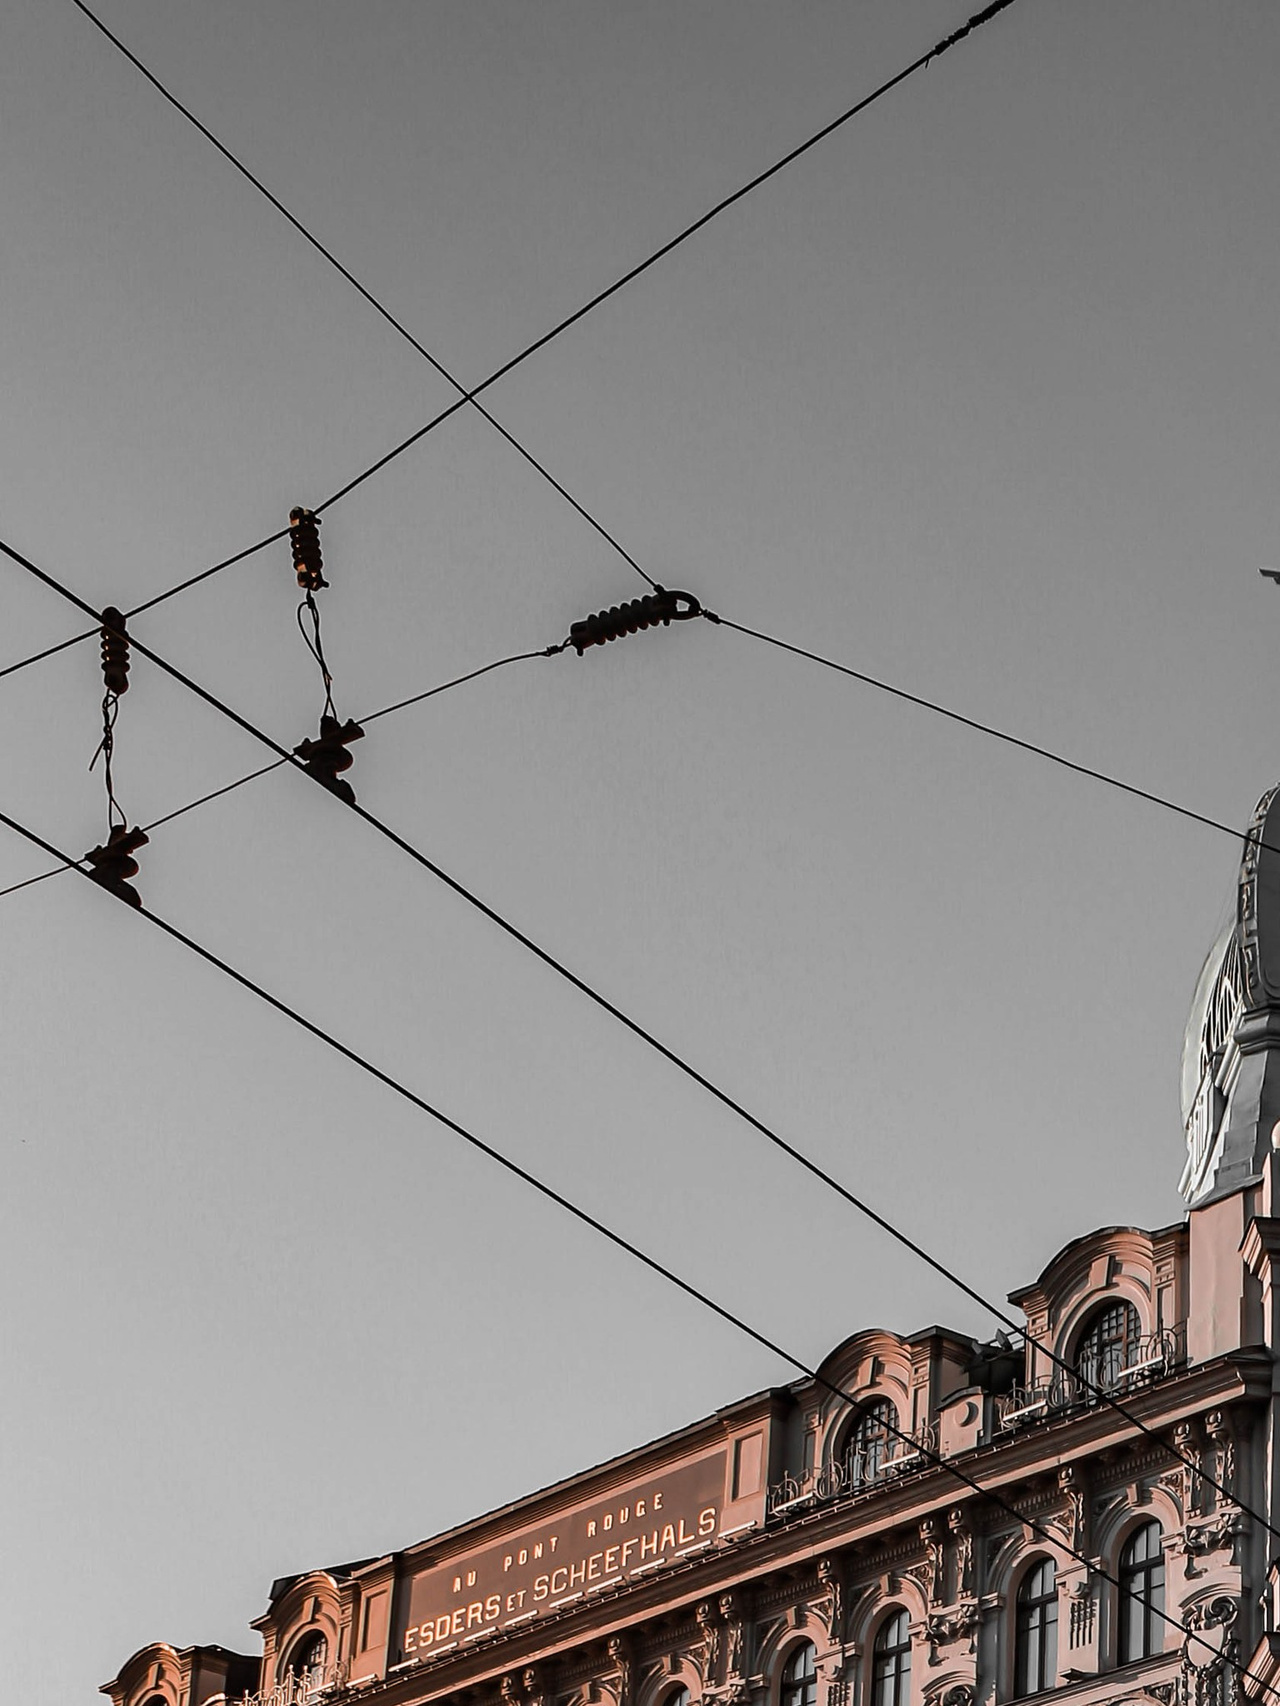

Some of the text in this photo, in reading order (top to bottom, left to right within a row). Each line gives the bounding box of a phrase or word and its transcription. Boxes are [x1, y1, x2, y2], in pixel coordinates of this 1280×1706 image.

[404, 1508, 717, 1654] ESDERS ET SCHEEFHALS
[453, 1493, 663, 1593] AU PONT ROUGE
